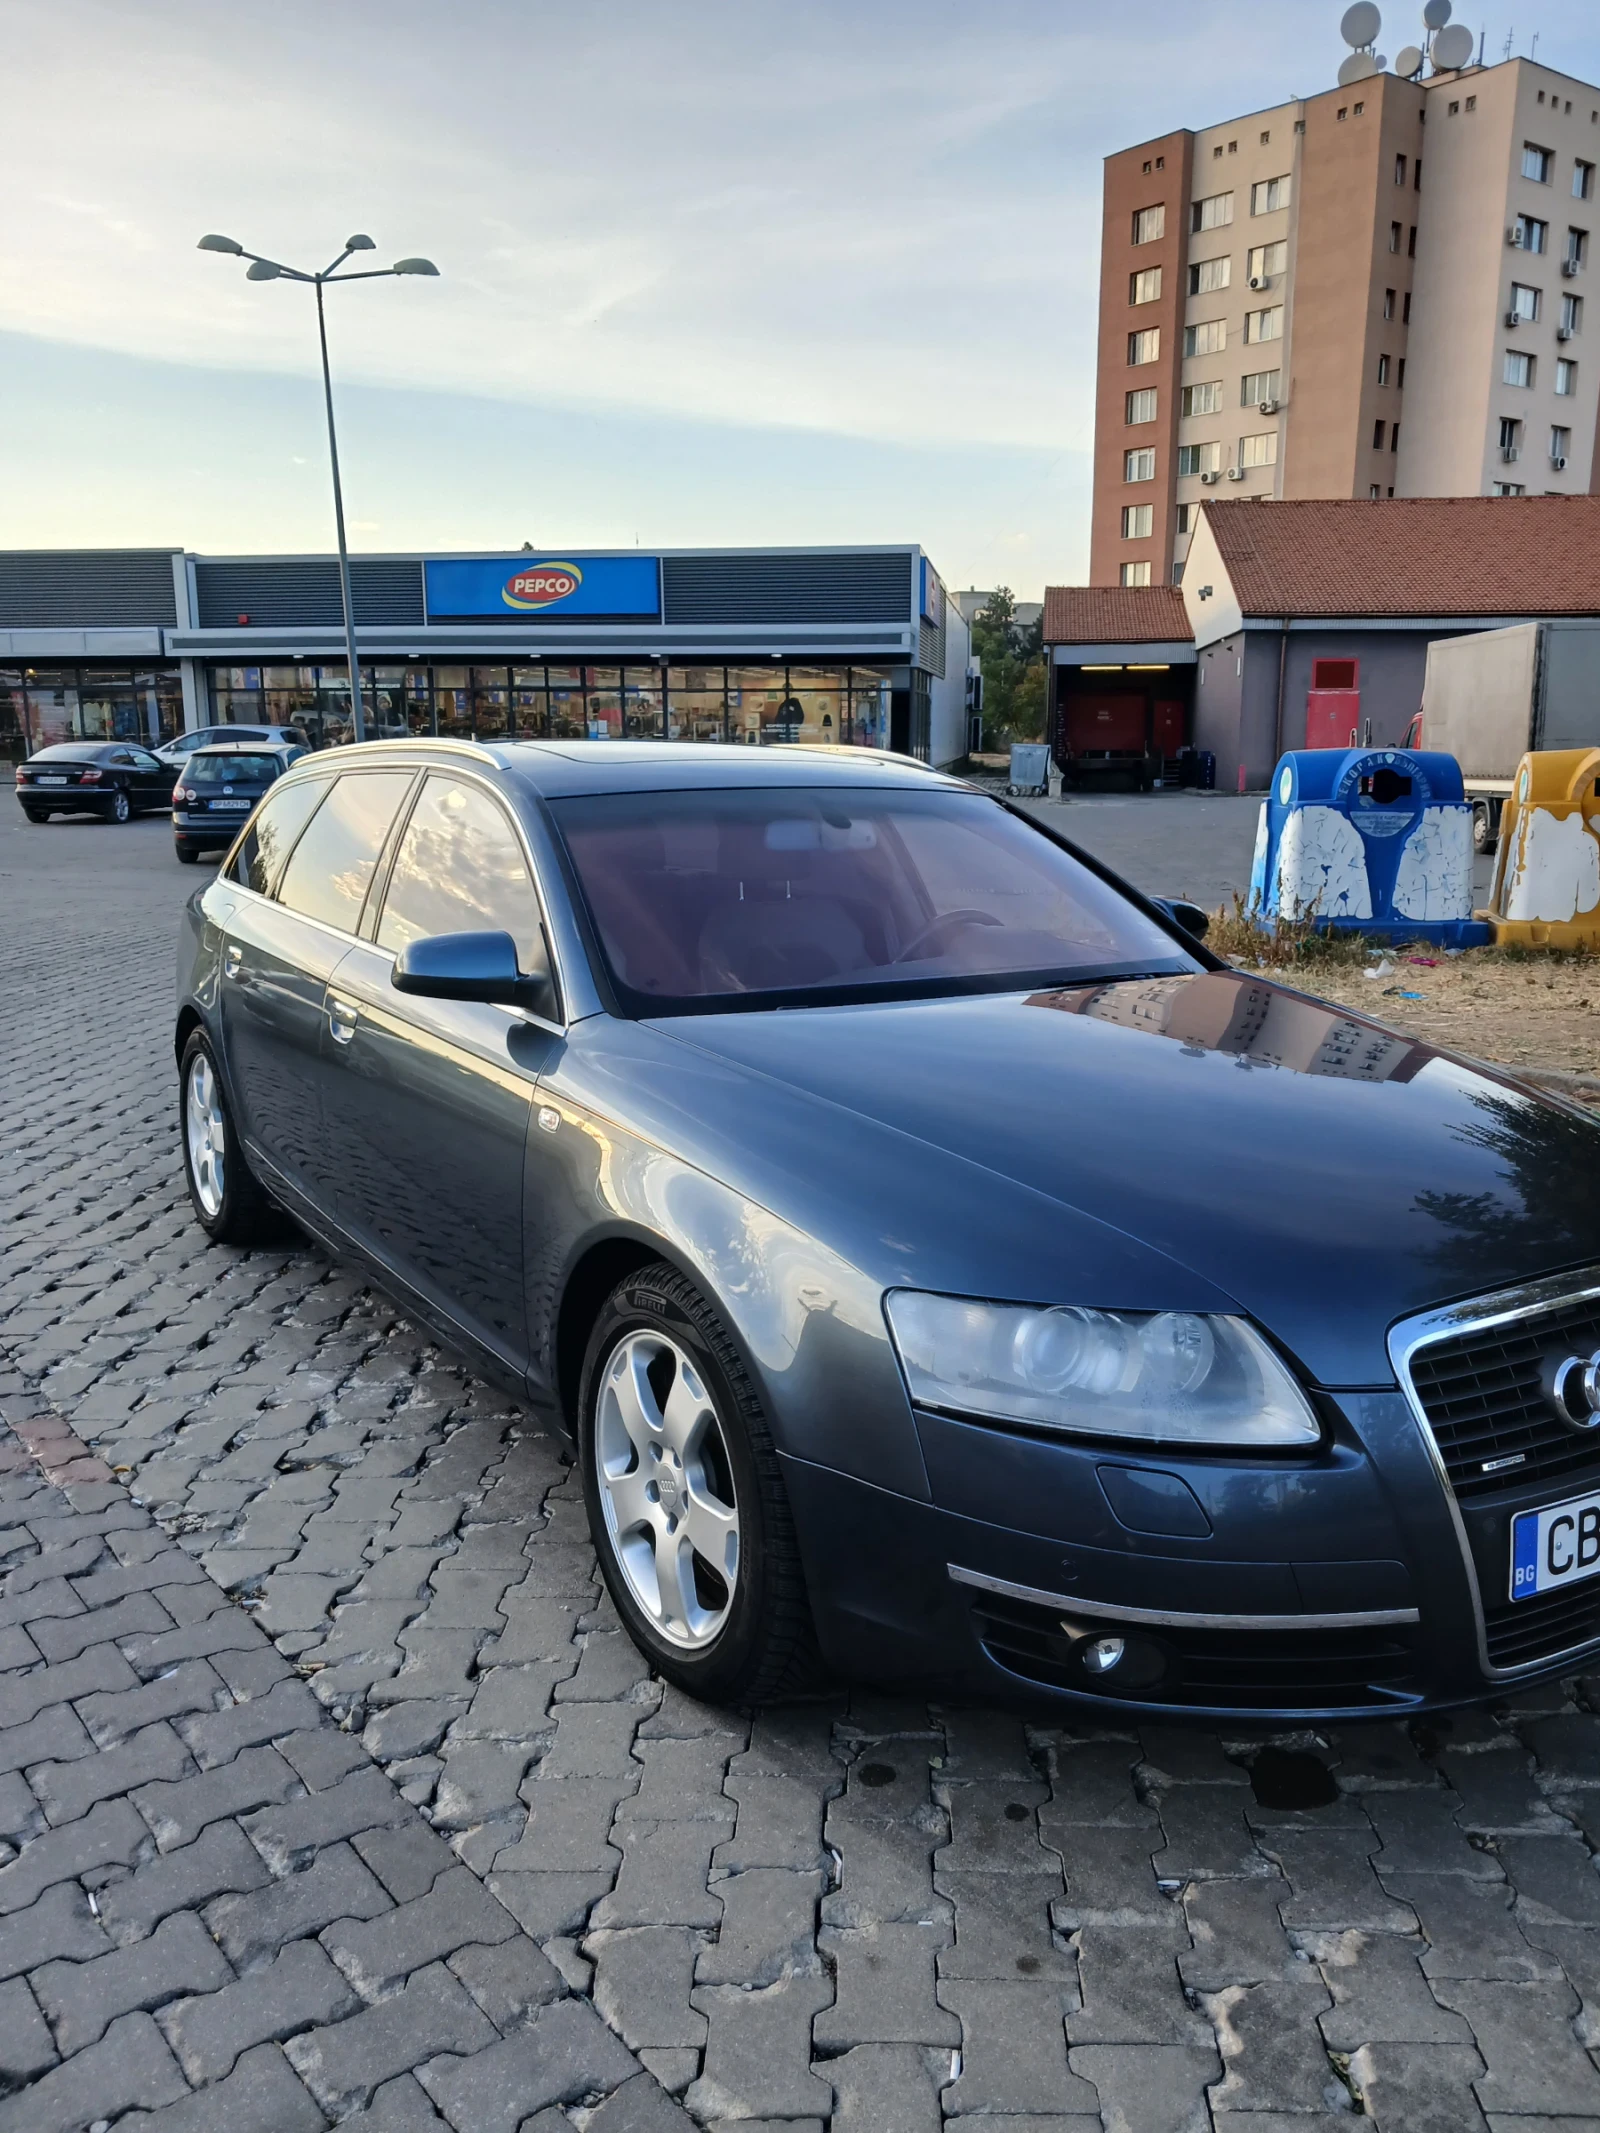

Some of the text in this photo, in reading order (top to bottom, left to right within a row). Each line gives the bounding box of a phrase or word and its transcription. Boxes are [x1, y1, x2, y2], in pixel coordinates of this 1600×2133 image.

[514, 578, 570, 593] PEPCO
[634, 1290, 667, 1315] PIRELLI
[1547, 1506, 1600, 1576] CB
[1515, 1564, 1535, 1586] BG
